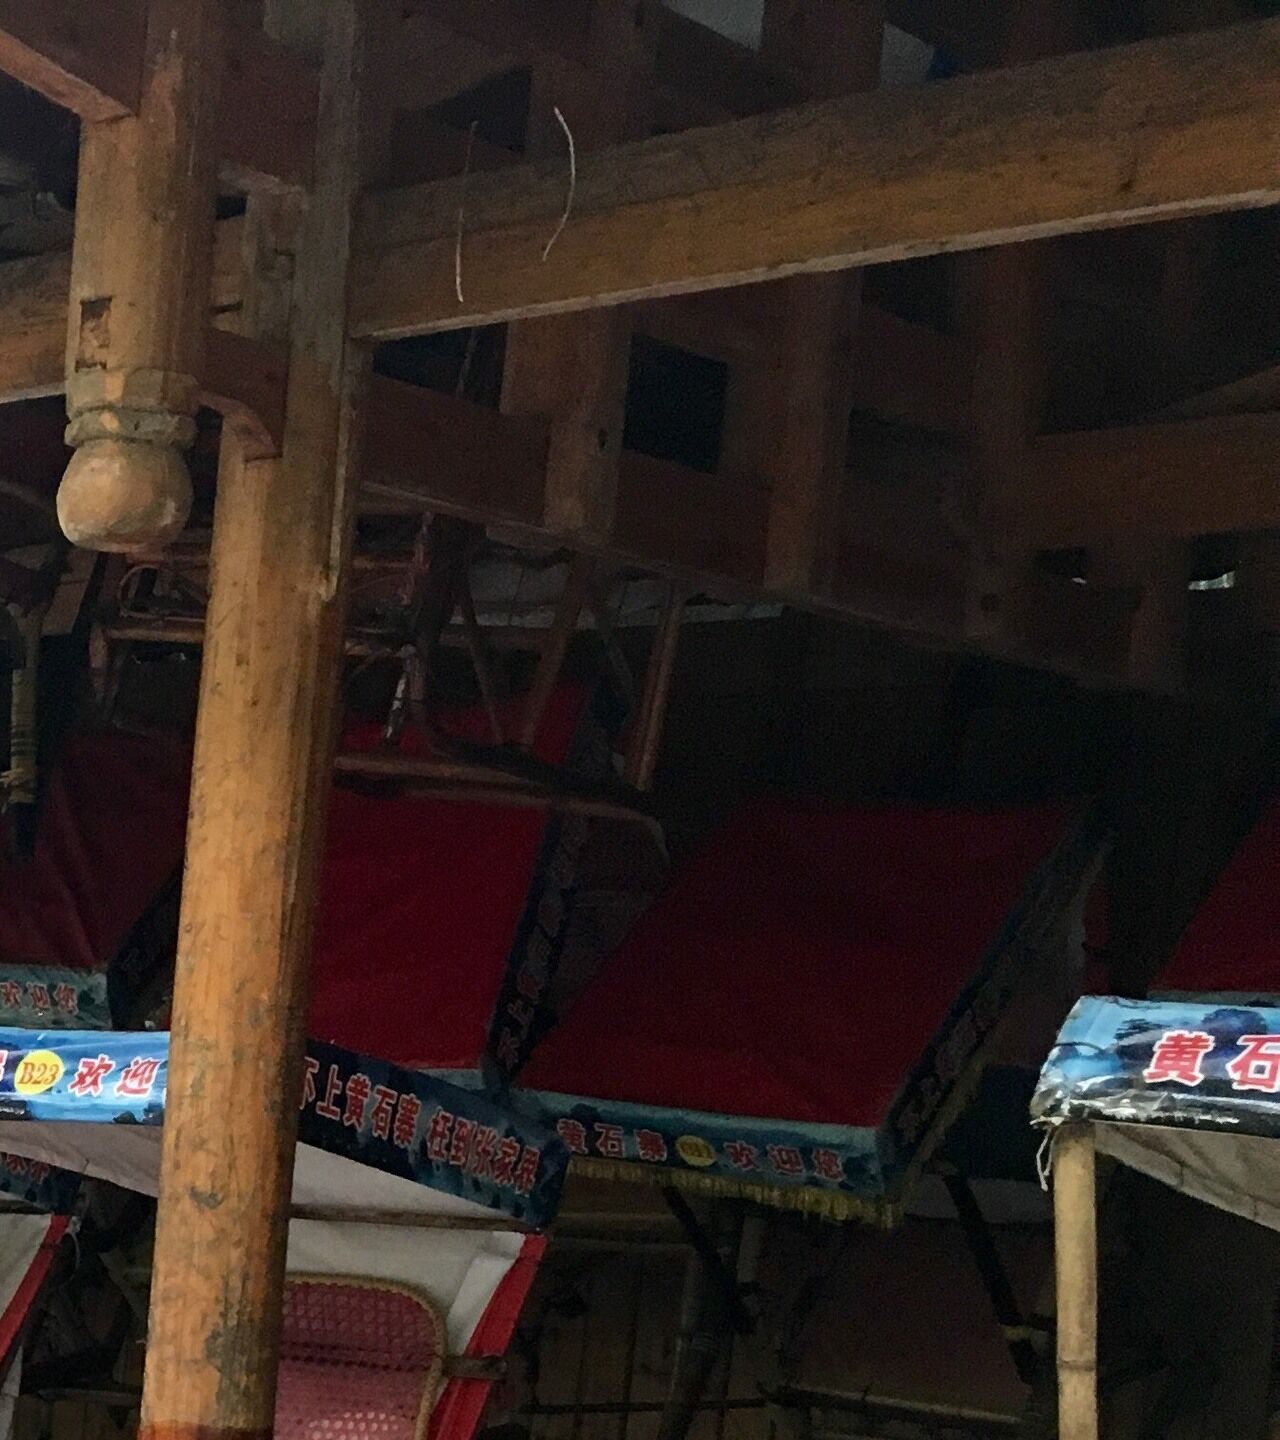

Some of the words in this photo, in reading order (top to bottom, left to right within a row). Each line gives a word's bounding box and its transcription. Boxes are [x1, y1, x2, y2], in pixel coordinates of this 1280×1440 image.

[17, 1062, 60, 1085] B23
[67, 1053, 168, 1104] 欢迎
[1142, 1029, 1280, 1094] 黄石
[556, 1117, 669, 1163] 黄石寨
